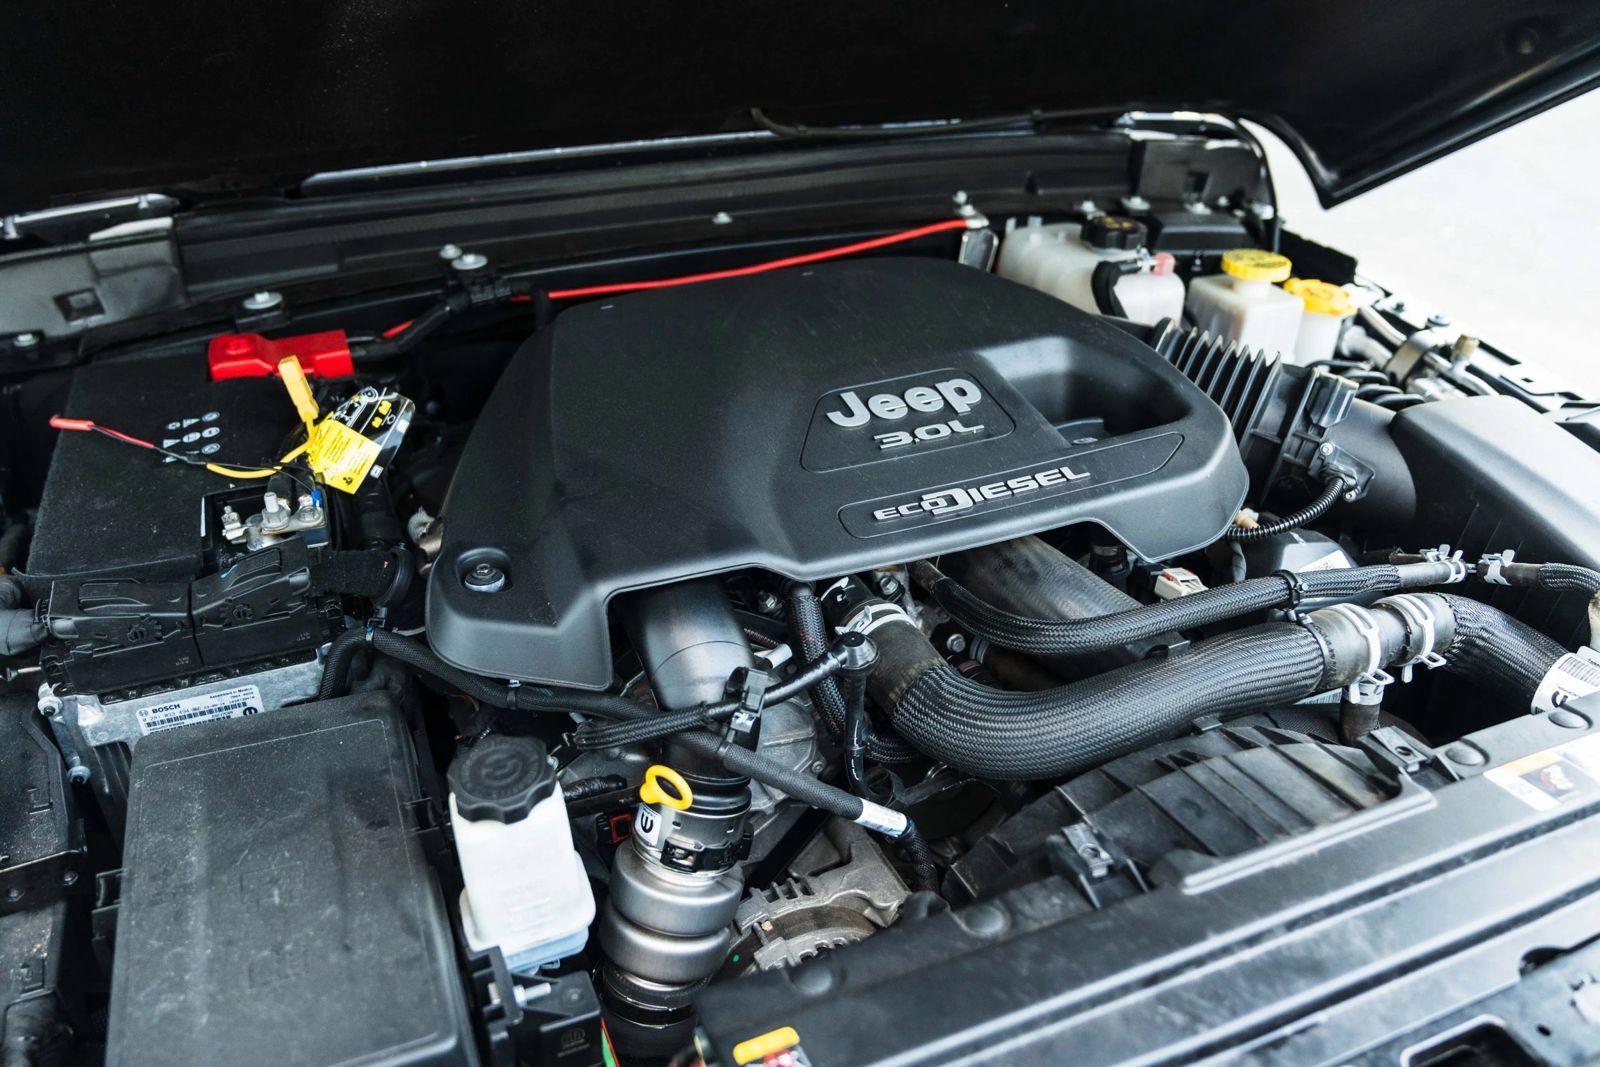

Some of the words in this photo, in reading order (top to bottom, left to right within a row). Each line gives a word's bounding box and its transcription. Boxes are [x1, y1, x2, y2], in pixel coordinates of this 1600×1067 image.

[826, 377, 982, 428] Jeep
[873, 419, 985, 449] 3.0L
[872, 466, 1091, 521] ECODIESEL
[152, 703, 180, 714] BOSCH
